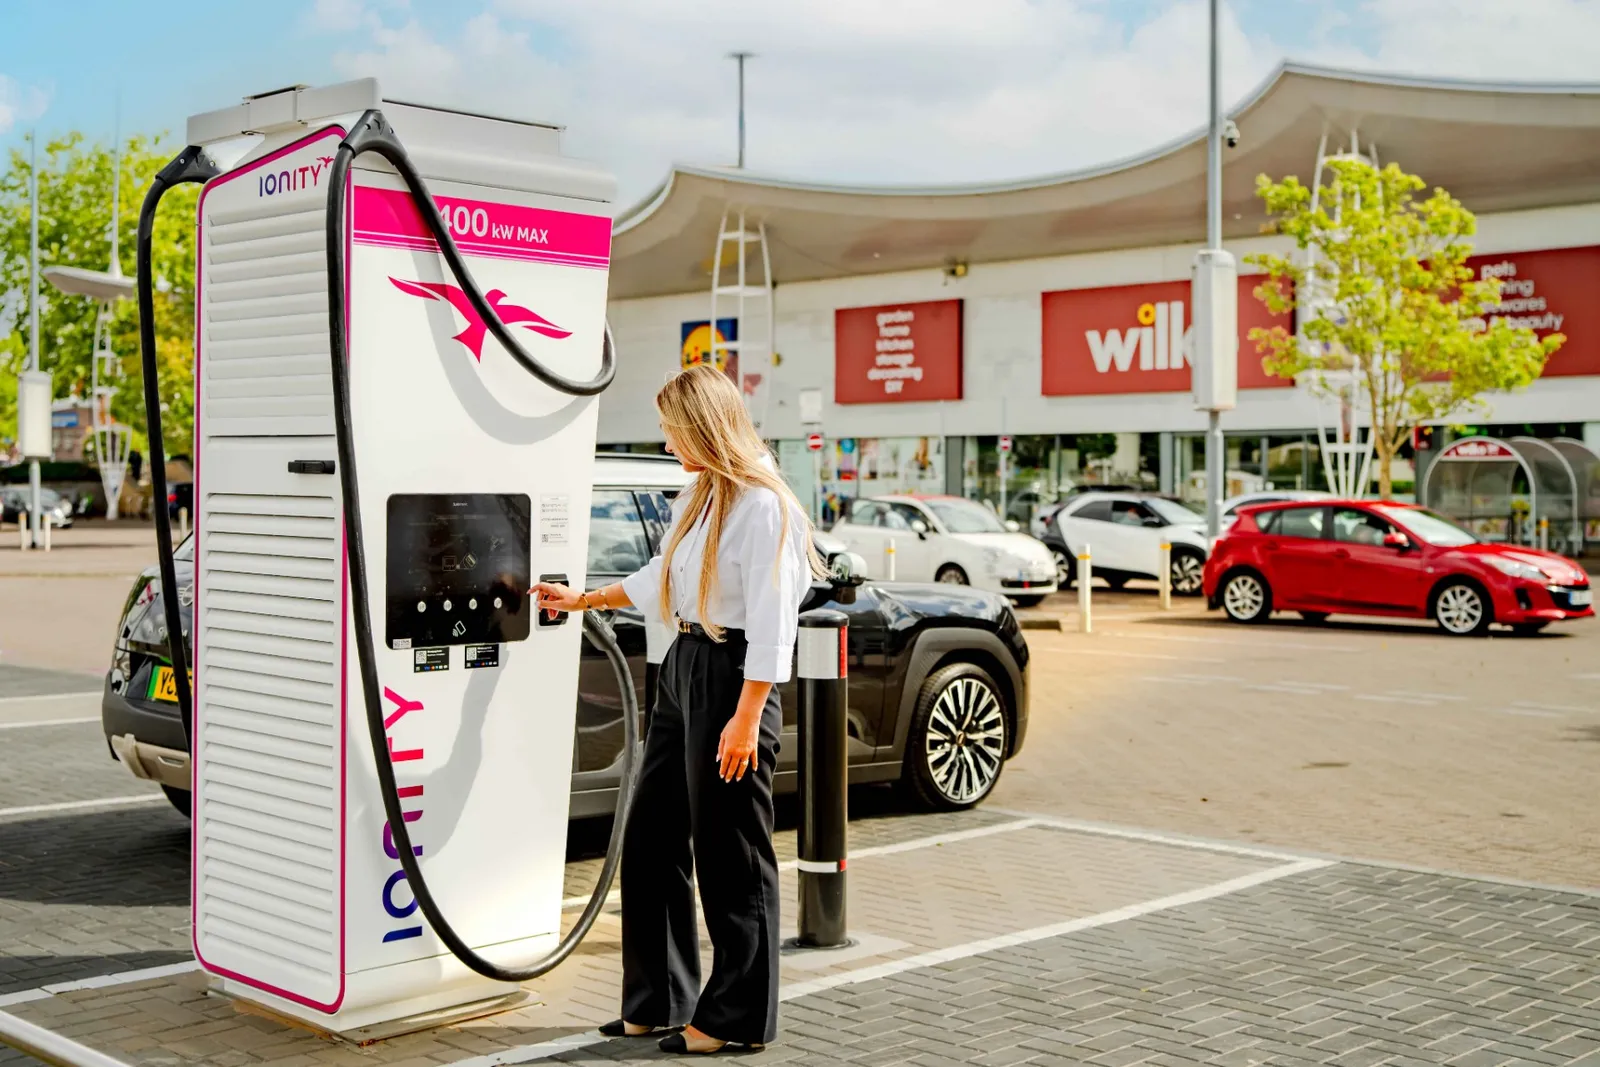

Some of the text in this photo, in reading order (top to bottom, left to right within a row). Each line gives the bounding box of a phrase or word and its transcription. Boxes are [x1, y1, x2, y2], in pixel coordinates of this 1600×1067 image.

[259, 164, 321, 197] IONITY
[440, 204, 549, 244] 400 kW MAX
[1085, 300, 1194, 373] wilk
